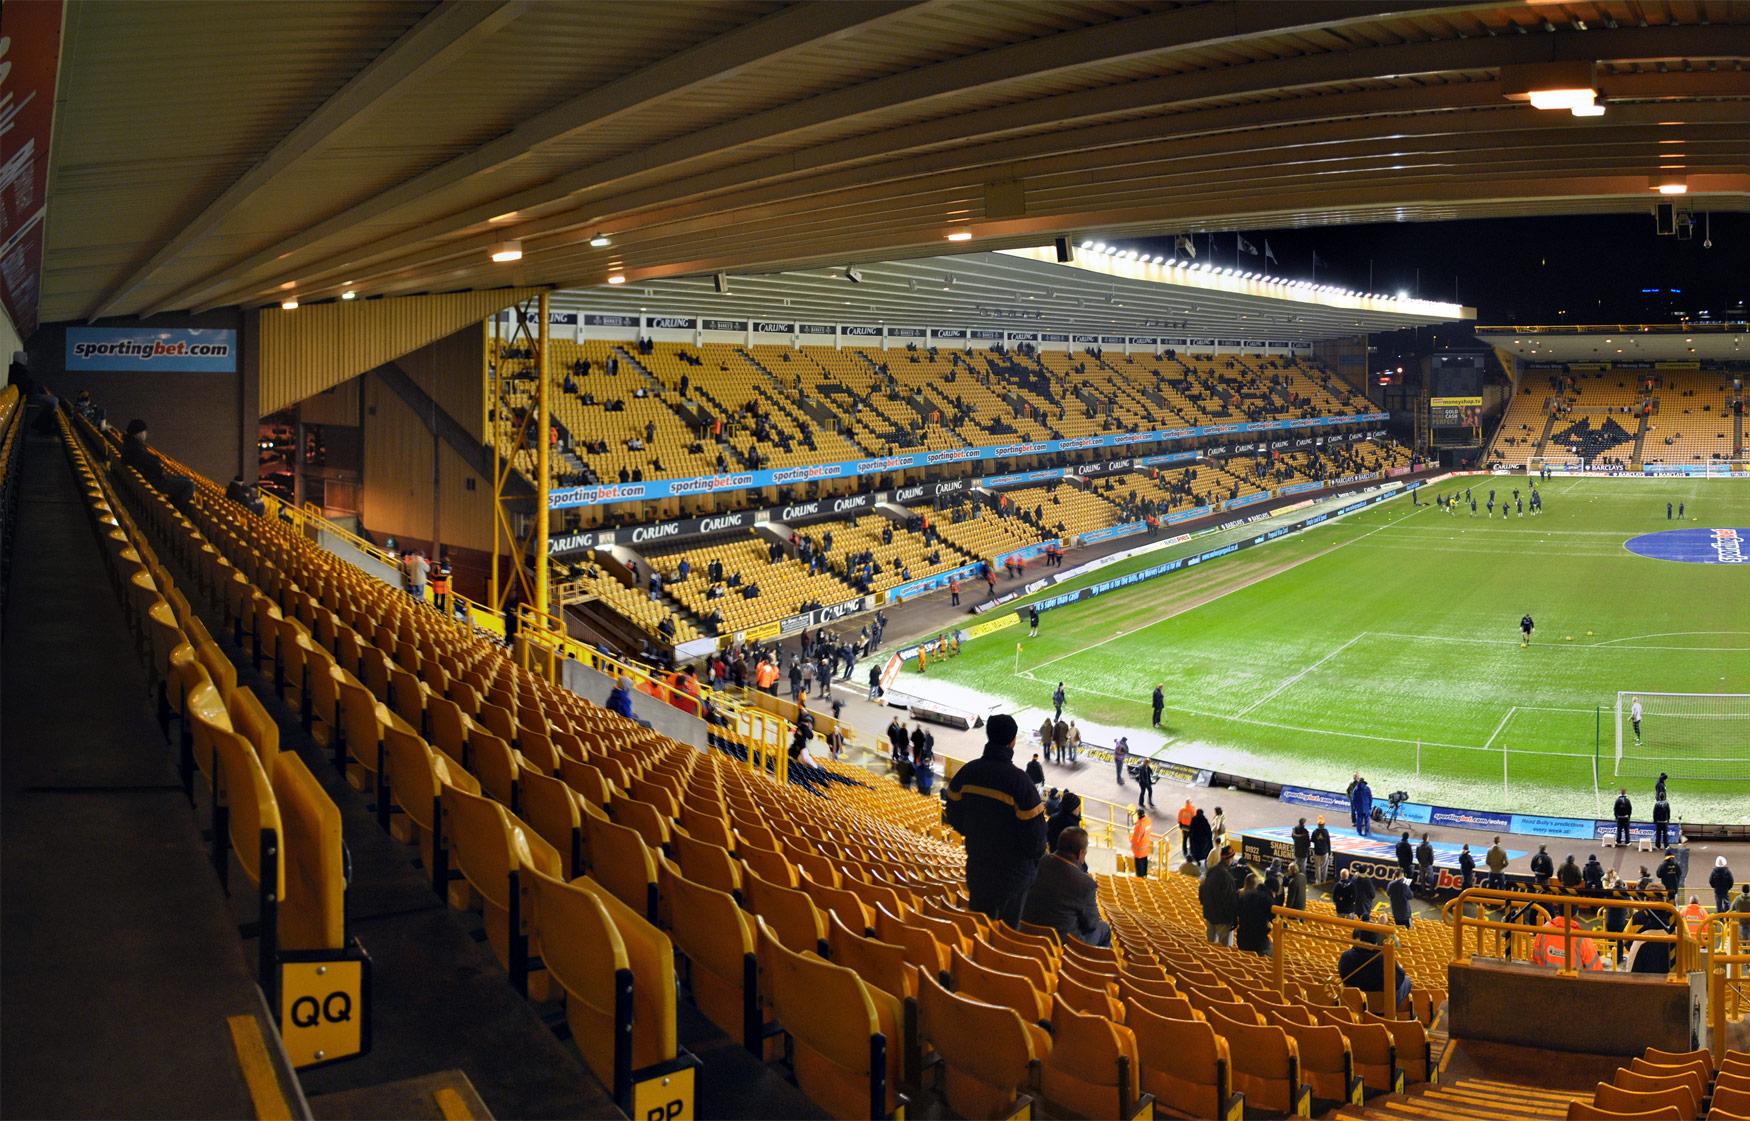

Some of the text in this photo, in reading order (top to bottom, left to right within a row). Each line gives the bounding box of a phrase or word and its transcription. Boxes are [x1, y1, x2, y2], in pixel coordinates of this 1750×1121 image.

[527, 312, 567, 323] CAING
[652, 318, 689, 328] CARLING
[758, 322, 788, 332] CARLING
[847, 326, 876, 336] CARLING
[938, 329, 960, 338] CARLING
[1012, 333, 1033, 341] CARLING
[1075, 335, 1095, 343] CARLING
[74, 338, 229, 361] sportingbet.com
[1203, 425, 1238, 434] sportingbet.com
[1248, 421, 1282, 431] sportingbet.com
[1114, 433, 1152, 444] sportingbet.com
[1163, 429, 1196, 439] sportingbet.com
[1059, 437, 1104, 449] sportingbet.com
[1271, 440, 1289, 449] CARLING
[1296, 437, 1312, 447] CARLING
[995, 443, 1047, 456] sportingbet.com
[1207, 447, 1226, 456] CARLING
[1235, 443, 1254, 453] CARLING
[927, 449, 980, 462] sportingbet.com
[858, 457, 913, 473] sportingbet.com
[1079, 464, 1101, 475] CARLING
[1109, 459, 1130, 470] CARLING
[1493, 463, 1520, 471] CARLING
[773, 465, 840, 482] sportingbet.com
[669, 474, 752, 495] sportingbet.com
[935, 480, 963, 495] CARLING
[548, 485, 645, 507] sportingbet.com
[896, 486, 924, 502] CARLING
[834, 495, 866, 512] CARLING
[782, 502, 818, 520] CARLING
[700, 514, 742, 532] CARLING
[1225, 512, 1269, 529] BARCLAYS BARCLAYS
[632, 522, 679, 543] CARLING
[1434, 811, 1508, 827] sportingbet.com/wolves
[290, 991, 352, 1028] QQ
